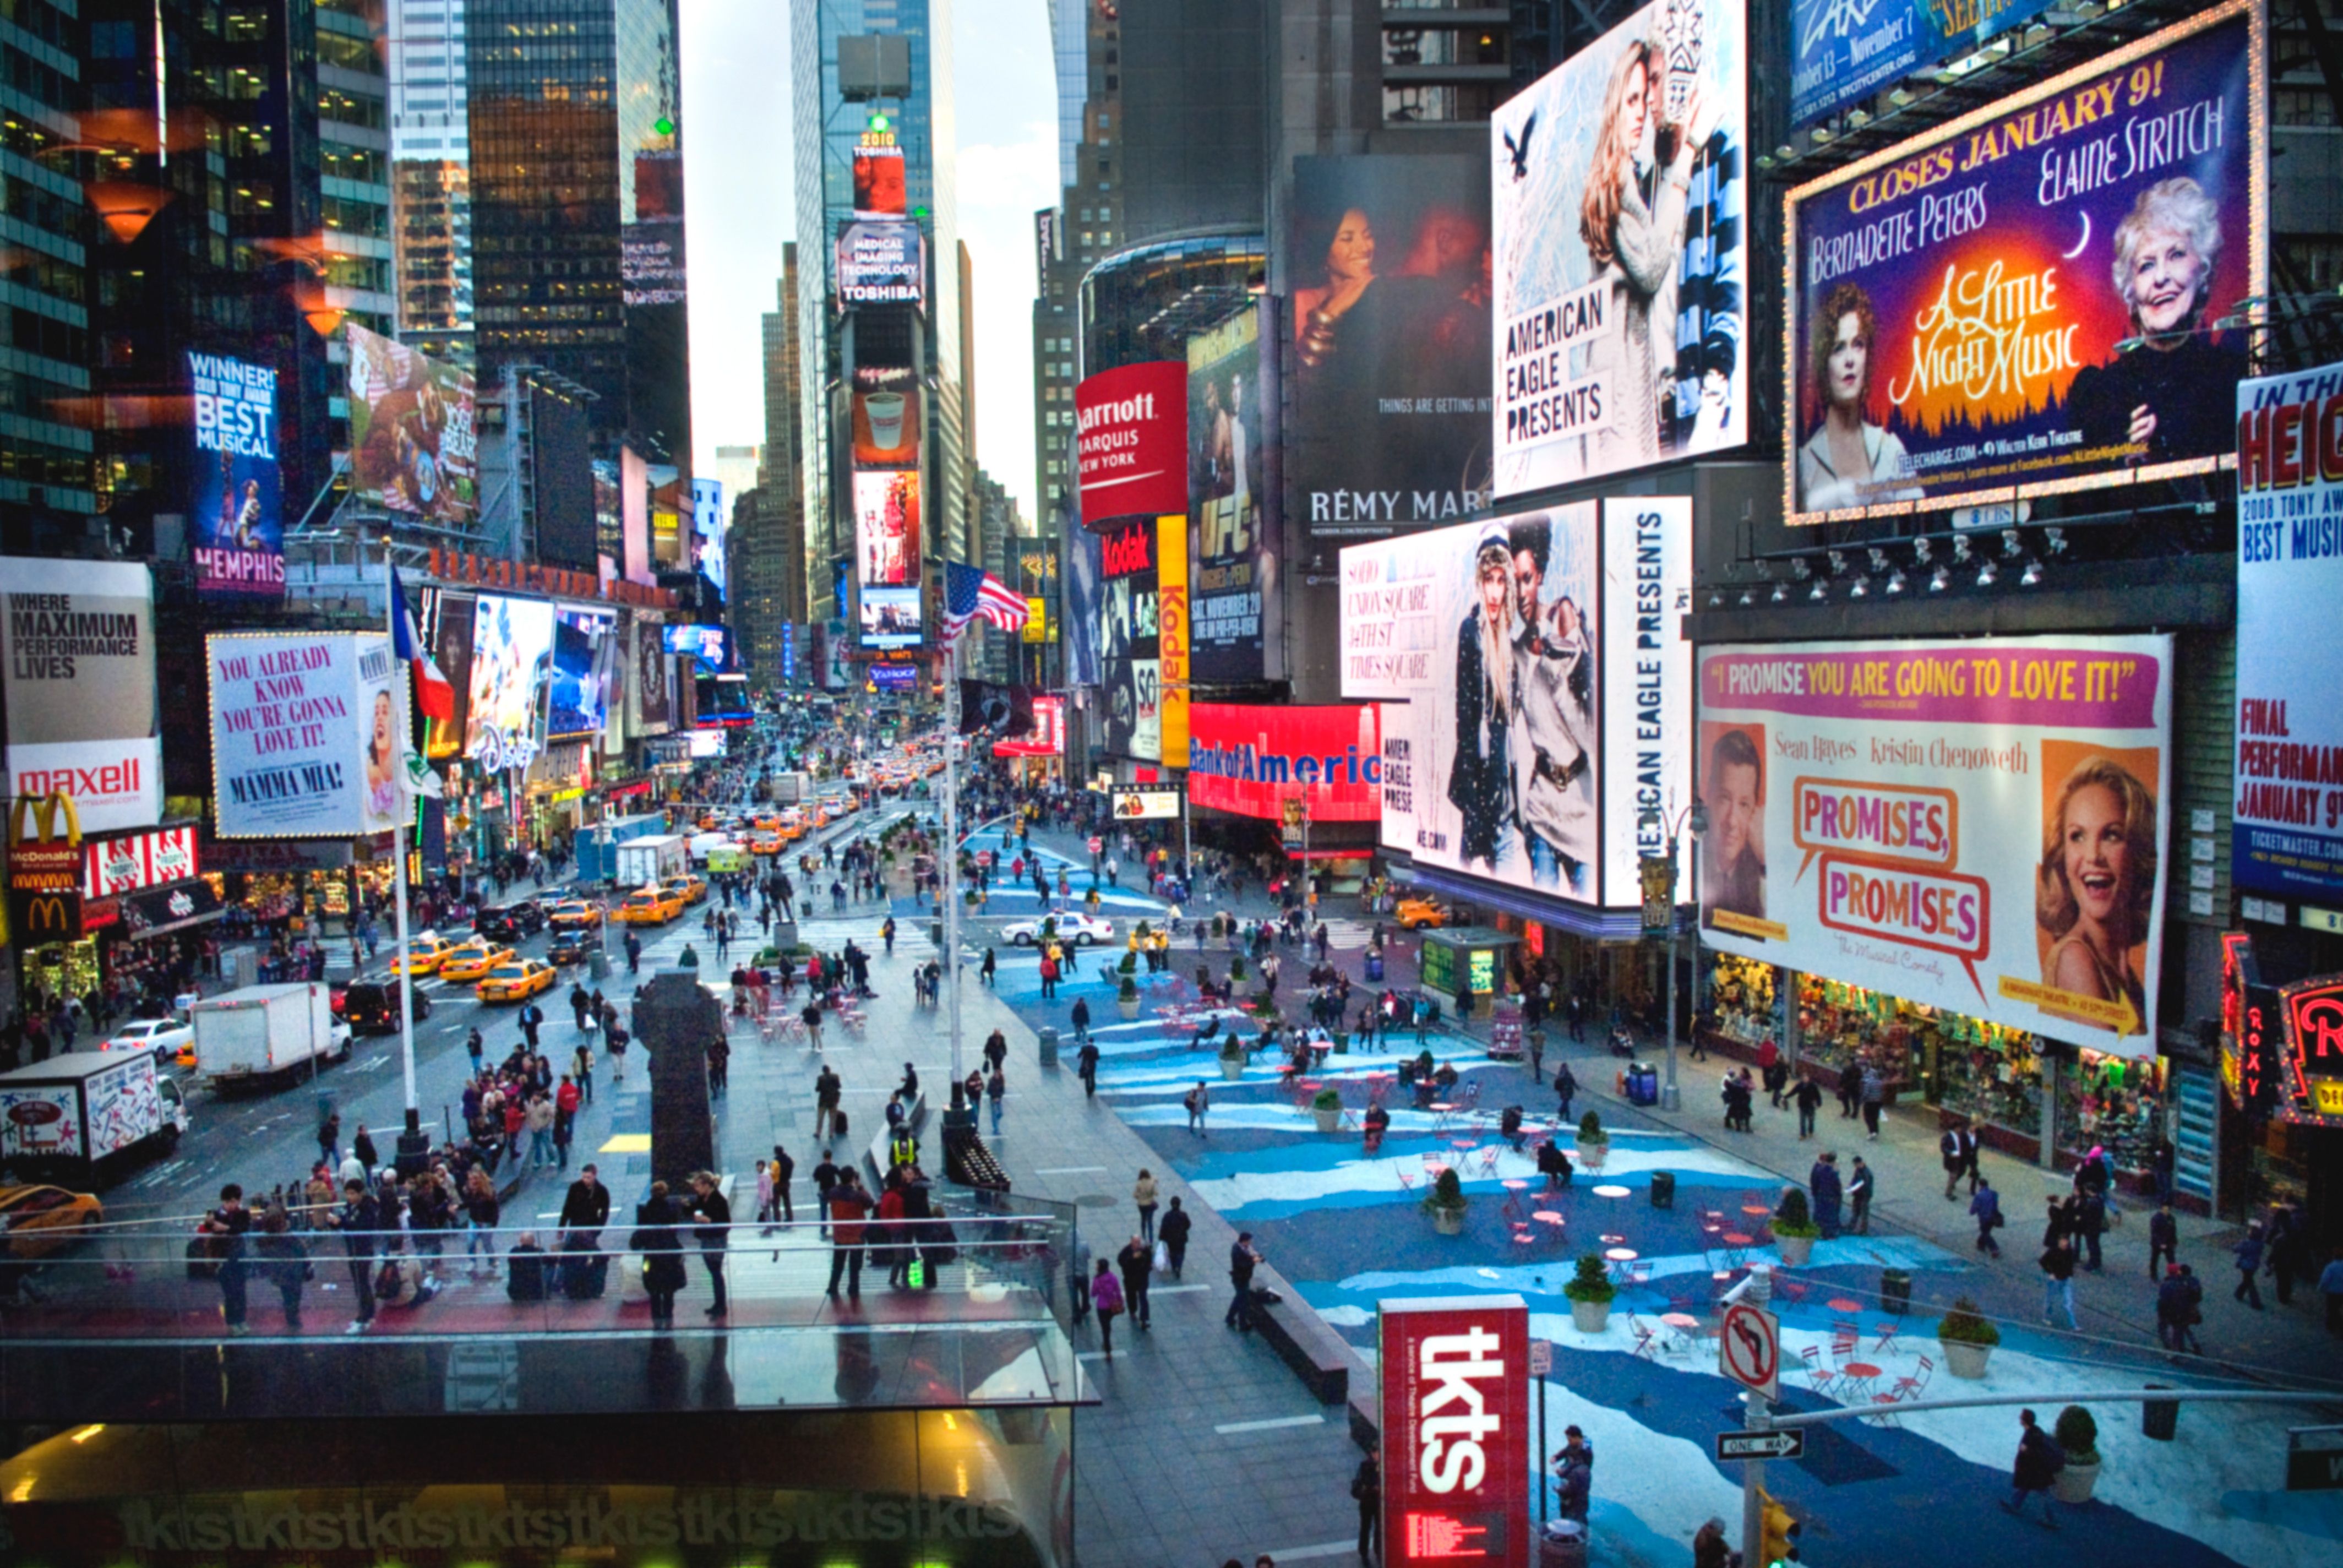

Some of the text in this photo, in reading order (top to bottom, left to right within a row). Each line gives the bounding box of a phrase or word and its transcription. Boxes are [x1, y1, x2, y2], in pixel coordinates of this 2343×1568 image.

[1850, 15, 1905, 66] November
[1839, 50, 1916, 99] NYCITYCENTER.ORG
[854, 145, 903, 157] TOSHIBA
[861, 132, 895, 146] 2010
[1849, 60, 2165, 214] CLOSES JANUARY 9!
[2121, 96, 2223, 179] STRITCH
[1919, 182, 1987, 248] PETERS
[854, 238, 904, 250] MEDICAL
[855, 252, 904, 262] IMAGING
[843, 264, 917, 275] TECHNOLOGY
[842, 286, 920, 300] TOSHIBA
[1506, 289, 1603, 361] AMERICAN
[188, 351, 274, 390] WINNER!
[1507, 351, 1559, 402] EAGLE
[1076, 393, 1154, 434] arriott
[1379, 398, 1413, 413] THINGS
[1415, 398, 1433, 413] ARE
[1436, 398, 1475, 412] GETTING
[1507, 383, 1601, 444] PRESENTS
[2254, 383, 2288, 411] IN
[195, 393, 272, 439] BEST
[197, 428, 274, 459] MUSICAL
[1079, 429, 1139, 455] ARQUIS
[1102, 451, 1136, 468] YORK
[1898, 445, 1976, 473] TELECHARGE.COM
[1311, 488, 1401, 522] RÉMY
[2243, 498, 2274, 521] 2008
[2280, 493, 2315, 518] TONY
[1201, 491, 1250, 559] UFC
[2243, 521, 2284, 563] BEST
[195, 547, 285, 582] MEMPHIS
[1102, 523, 1149, 577] Kodak
[1637, 512, 1662, 650] PRESENTS
[8, 593, 70, 611] WHERE
[1383, 584, 1430, 619] SQUARE
[11, 612, 137, 637] MAXIMUM
[12, 638, 138, 656] PERFORMANCE
[1161, 585, 1186, 703] Kodak
[14, 656, 75, 679] LIVES
[219, 656, 253, 682] YOU
[258, 644, 331, 678] ALREADY
[870, 668, 916, 679] YAHOO!
[1383, 654, 1430, 685] SQUARE
[1729, 661, 1805, 696] PROMISE
[1807, 660, 1845, 696] YOU
[1849, 661, 1890, 697] ARE
[1895, 657, 1966, 697] GOING
[1971, 657, 2002, 698] TO
[2008, 659, 2077, 701] LOVE
[254, 674, 306, 704] KNOW
[1637, 661, 1662, 741] EAGLE
[222, 694, 347, 734] YOU'RE GONNA
[2240, 698, 2289, 737] FINAL
[253, 722, 326, 756] LOVE IT!
[1190, 736, 1224, 776] Bank
[1774, 731, 2029, 775] Sean Hayes Kristin Chenoweth
[19, 757, 140, 798] maxell
[230, 761, 344, 805] MAMMA MIA!
[1384, 763, 1412, 788] EAGLE
[2237, 782, 2320, 827] JANUARY
[1803, 788, 1950, 858] PROMISES,
[10, 851, 79, 863] McDonald's
[1830, 870, 1977, 944] PROMISES
[1900, 951, 1945, 986] Comedy
[2247, 1007, 2264, 1097] ROXY
[2321, 1088, 2343, 1106] DE
[1408, 1344, 1416, 1374] service
[1408, 1375, 1416, 1385] of
[1407, 1386, 1418, 1417] Theatre
[1420, 1326, 1505, 1494] tkts
[1408, 1418, 1419, 1472] Development
[1729, 1438, 1790, 1452] ONE WAY
[1408, 1472, 1419, 1494] Fund
